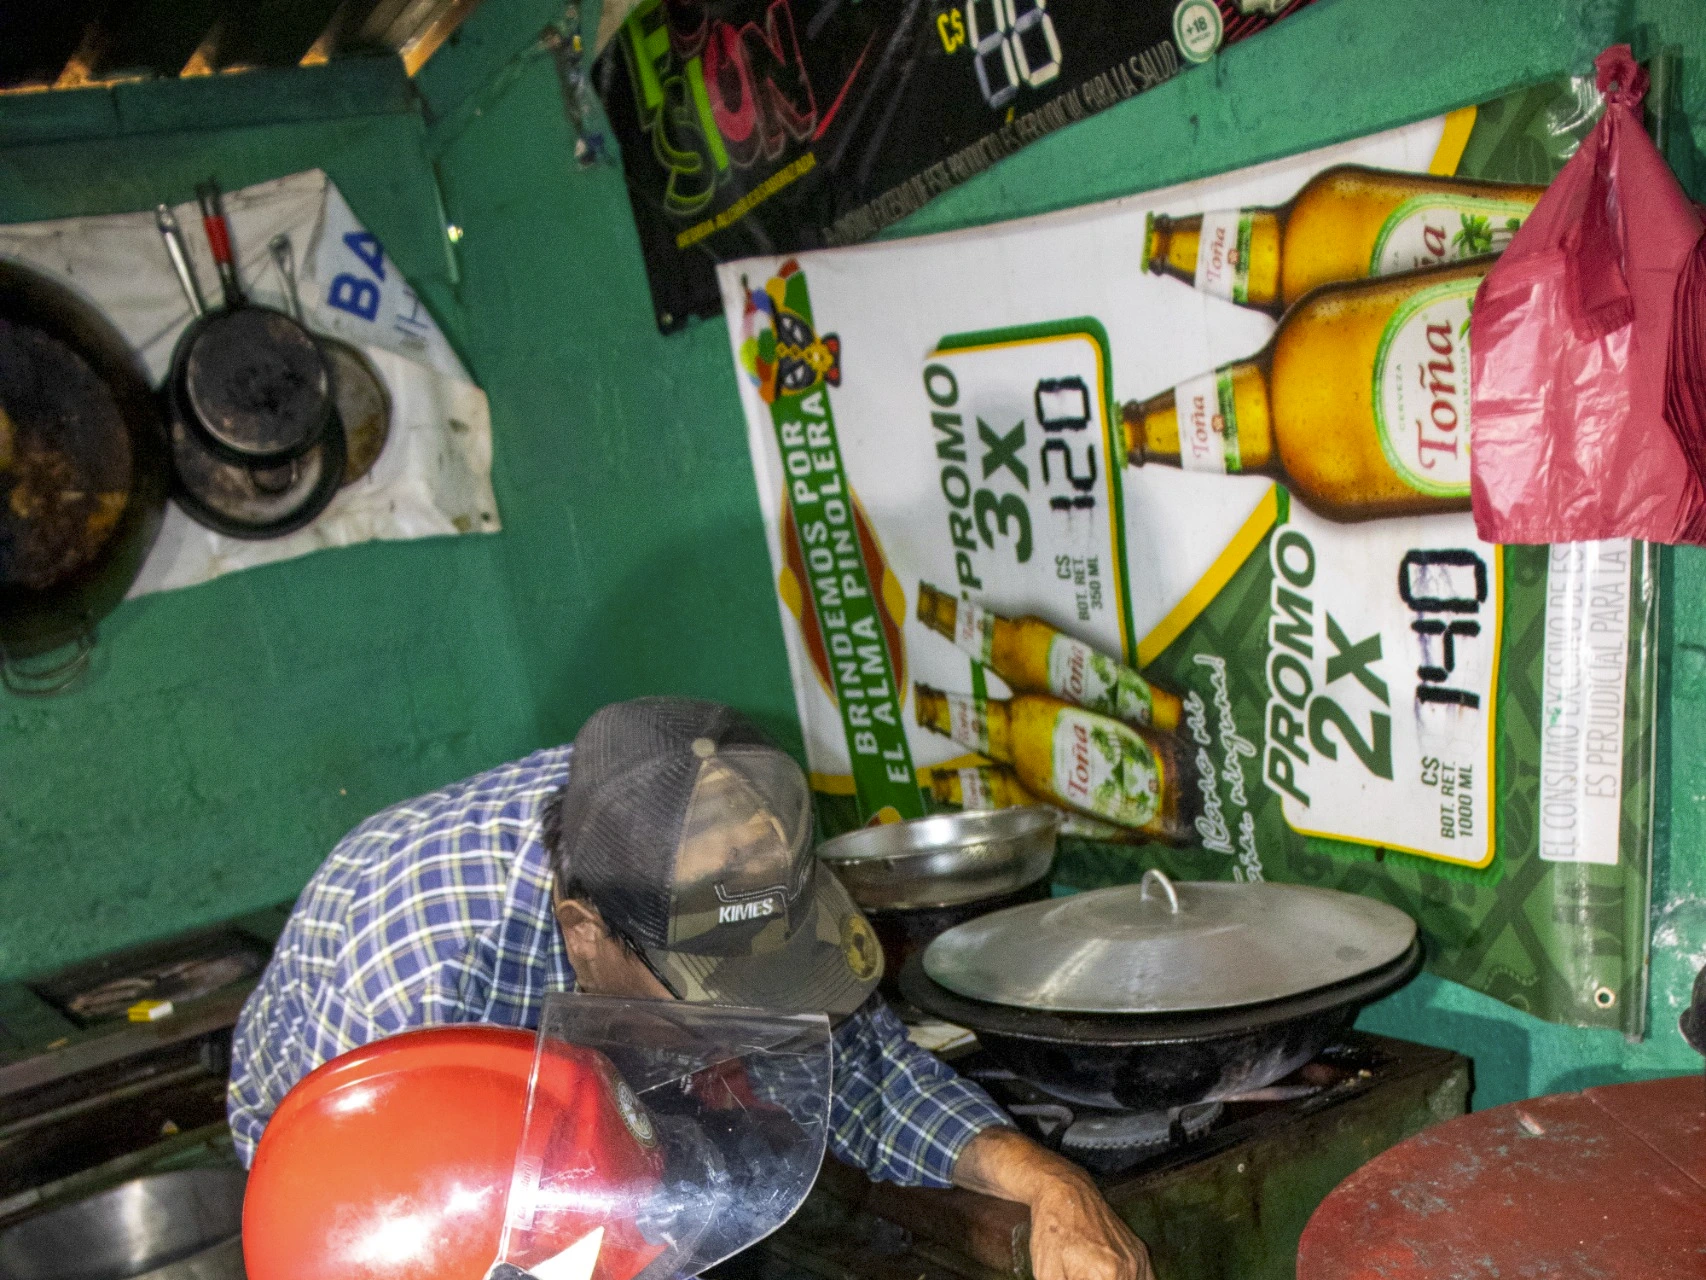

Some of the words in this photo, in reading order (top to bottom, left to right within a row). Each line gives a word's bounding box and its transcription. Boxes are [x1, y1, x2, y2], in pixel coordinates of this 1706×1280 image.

[1186, 17, 1208, 36] +18
[1129, 40, 1178, 89] SALUD
[1207, 225, 1227, 285] Toña
[1396, 363, 1406, 432] CERVEZA
[1416, 319, 1459, 469] Toña
[1035, 375, 1098, 513] 120
[1189, 396, 1210, 458] Toña
[781, 422, 817, 503] POR
[924, 363, 984, 592] PROMO
[801, 394, 869, 599] PINOLERA
[1089, 555, 1100, 575] ML
[1090, 578, 1102, 609] 350
[1593, 551, 1626, 574] LA
[1551, 583, 1583, 608] DE
[1591, 583, 1625, 633] PARA
[802, 521, 879, 755] BRINDEMOS
[1399, 547, 1488, 708] 140
[860, 619, 896, 725] ALMA
[1268, 531, 1316, 807] PROMO
[1308, 613, 1395, 780] 2X
[1548, 616, 1583, 716] EXCESIVO
[1193, 653, 1257, 806] ninguna!
[1586, 642, 1622, 767] PERJUDICIAL
[887, 743, 910, 784] EL
[1067, 724, 1089, 797] Toña
[1441, 761, 1455, 797] RET.
[1459, 764, 1472, 789] ML
[1544, 725, 1578, 829] CONSUMO
[1585, 774, 1618, 799] ES
[1440, 803, 1455, 839] BOT.
[1458, 794, 1473, 837] 1000
[1543, 837, 1576, 857] EL
[719, 898, 774, 924] KIMES
